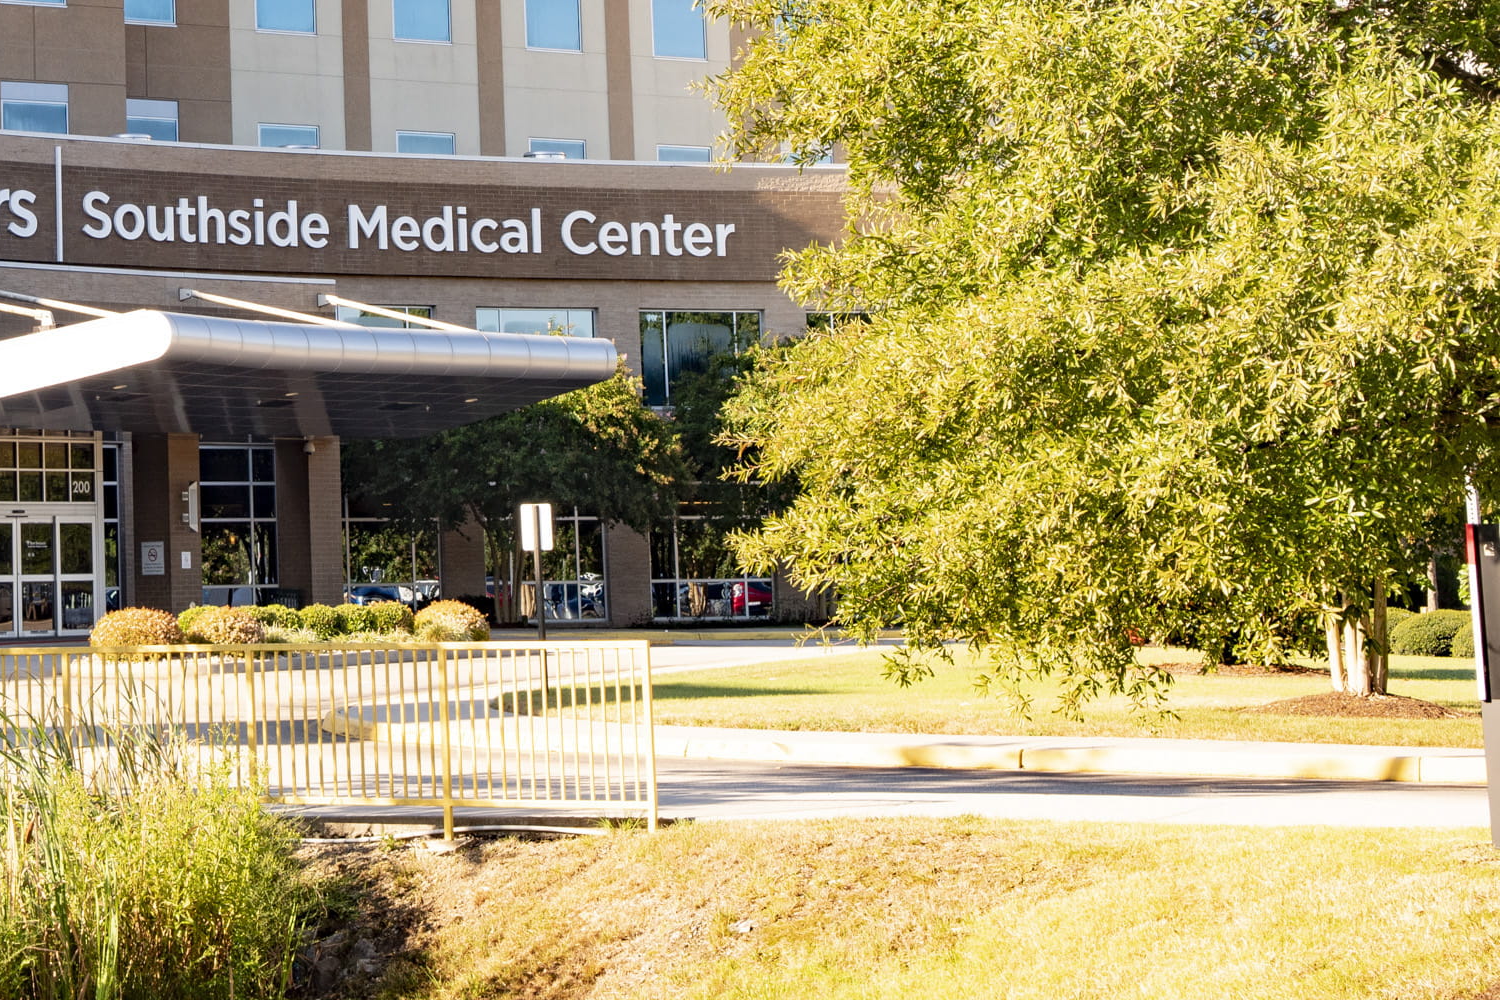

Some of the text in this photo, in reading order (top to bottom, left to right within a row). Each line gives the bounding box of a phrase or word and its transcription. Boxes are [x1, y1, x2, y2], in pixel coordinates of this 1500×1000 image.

[82, 190, 737, 258] Southside Medical Center
[72, 480, 91, 494] 200
